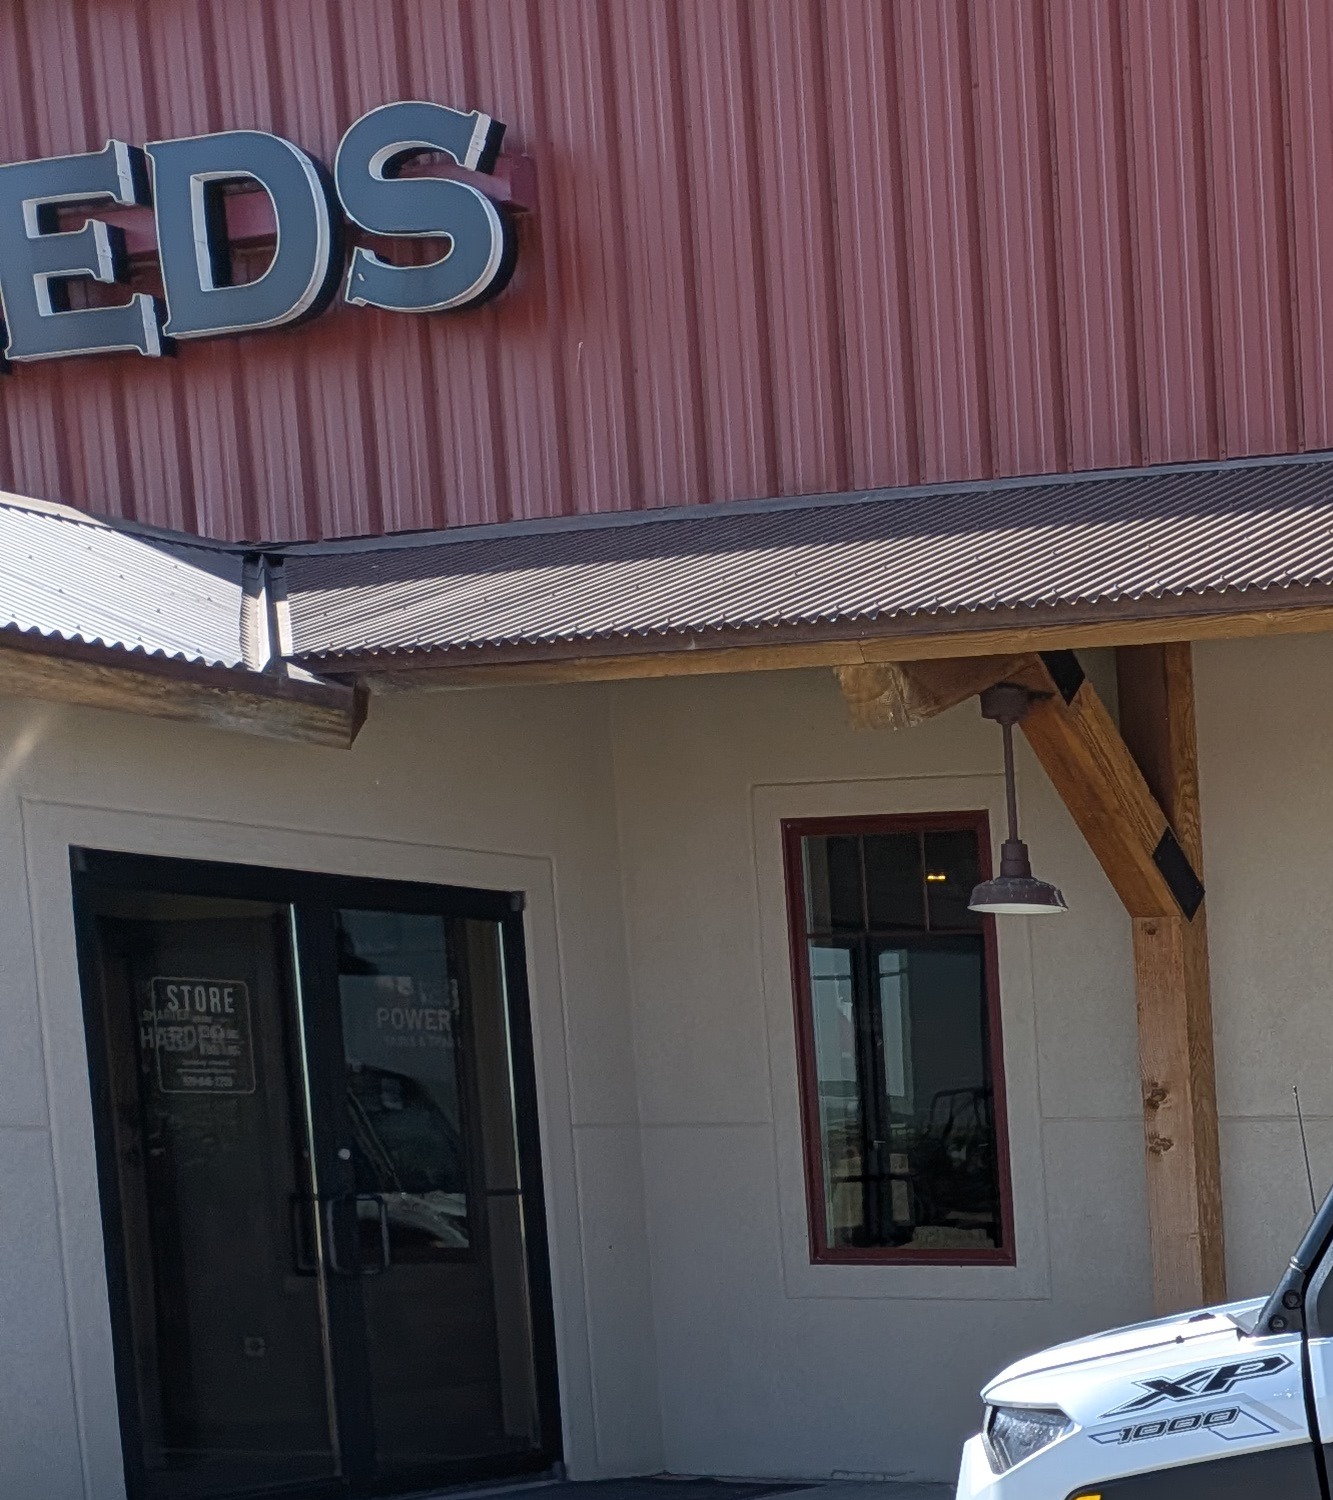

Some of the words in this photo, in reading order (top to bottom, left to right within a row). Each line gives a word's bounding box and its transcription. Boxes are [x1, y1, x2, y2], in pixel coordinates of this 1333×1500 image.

[0, 100, 504, 360] EDS
[166, 984, 235, 1014] STORE
[376, 1007, 451, 1032] POWER
[1097, 1353, 1294, 1419] XP
[1117, 1406, 1240, 1445] 1000
